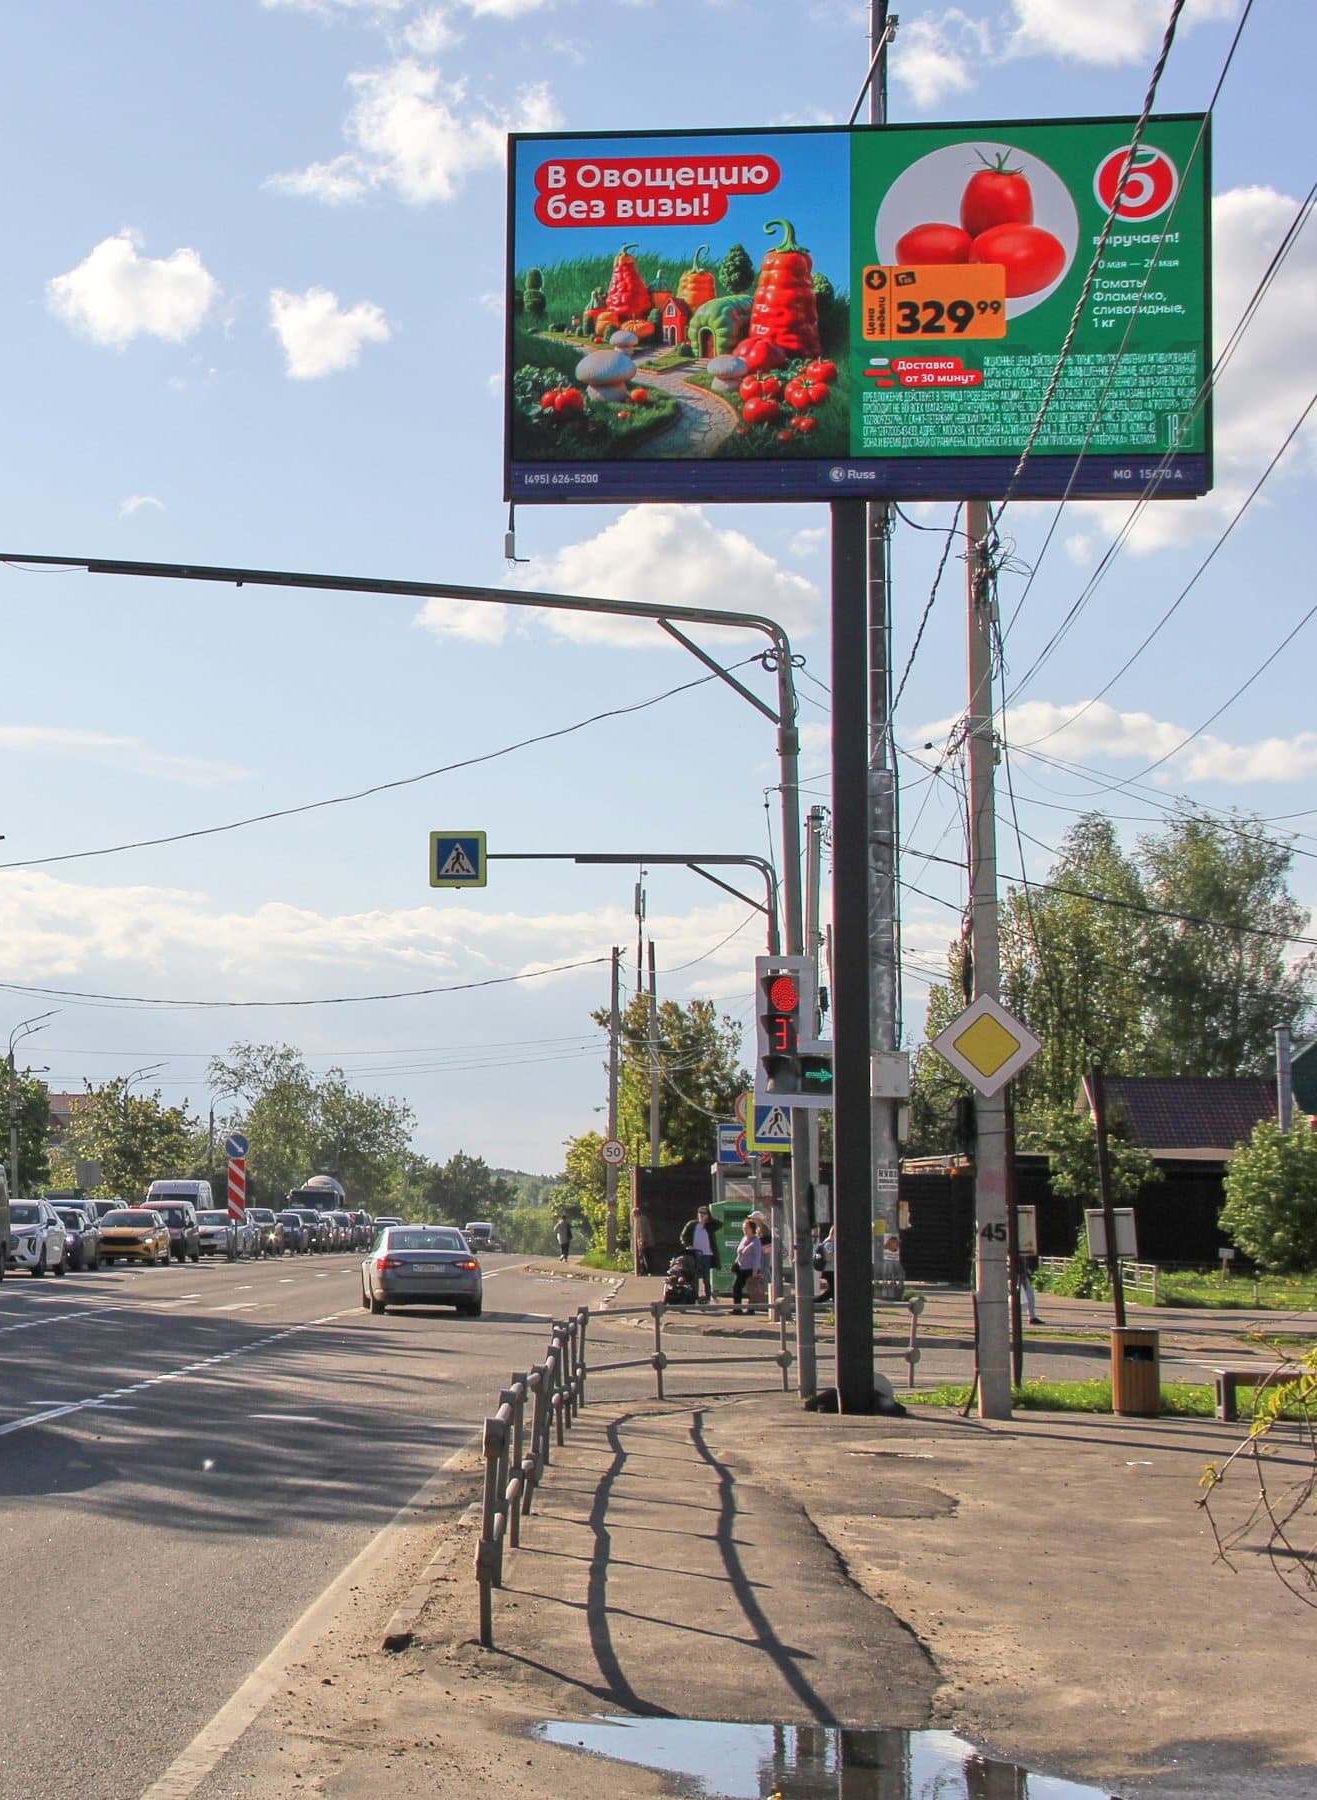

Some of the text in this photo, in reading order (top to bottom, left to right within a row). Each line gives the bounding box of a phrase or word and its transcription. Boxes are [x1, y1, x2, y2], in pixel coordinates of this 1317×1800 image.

[547, 164, 770, 190] В Овощецию
[546, 193, 710, 219] без визы!
[1092, 232, 1180, 247] выручает!
[1107, 260, 1127, 269] мая
[1158, 260, 1179, 268] мая
[1092, 278, 1147, 288] Томаты
[1092, 291, 1167, 302] Фламенко,
[877, 296, 886, 335] недели
[867, 308, 876, 335] Цена
[1092, 318, 1116, 328] 1 кг
[897, 360, 954, 371] Доставка
[905, 374, 976, 384] от 30 минут
[551, 473, 599, 484] 626-5200
[847, 469, 876, 480] Russ
[606, 1147, 621, 1157] 50
[980, 1223, 1007, 1242] 45
